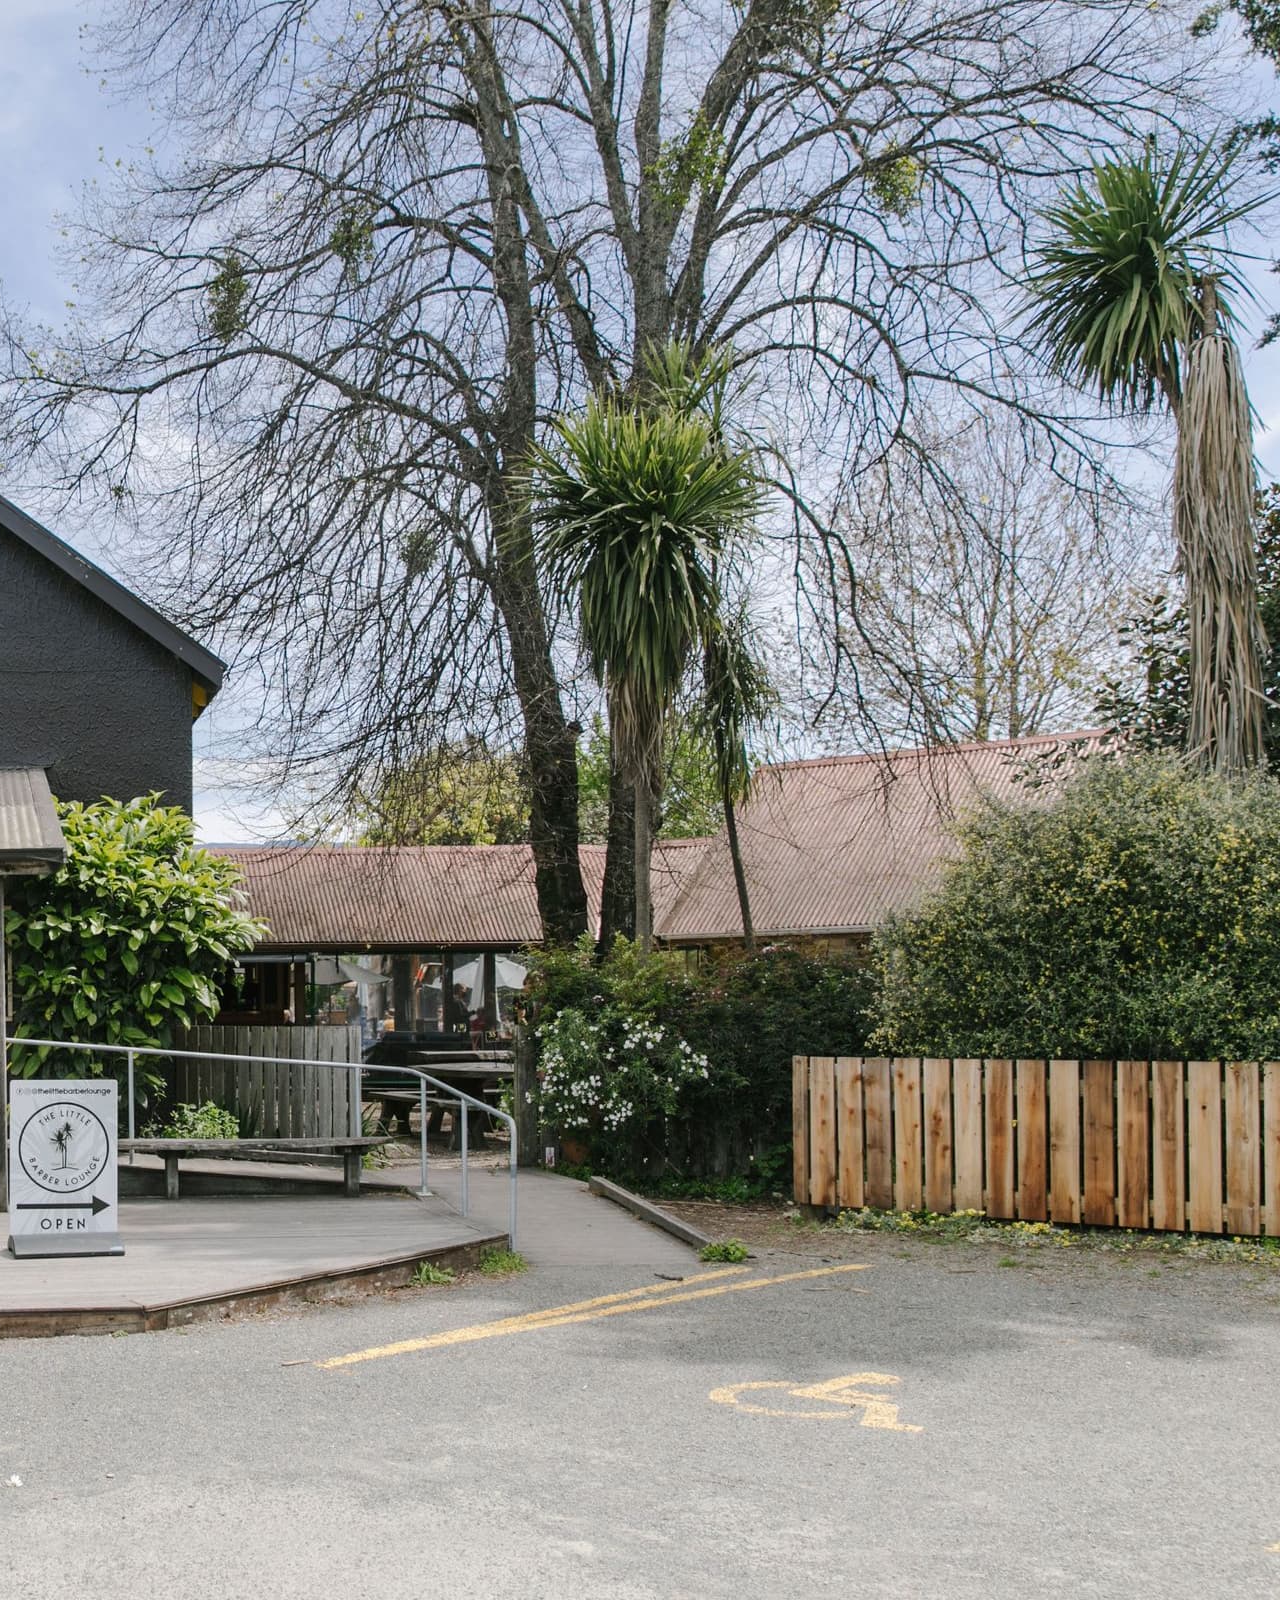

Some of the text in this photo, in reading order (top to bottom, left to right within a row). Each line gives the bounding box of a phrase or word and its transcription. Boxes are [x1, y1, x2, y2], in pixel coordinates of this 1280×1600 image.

[38, 1110, 92, 1127] THE LITTLE
[28, 1156, 101, 1187] BARBER LOUNGE
[40, 1218, 87, 1230] OPEN
